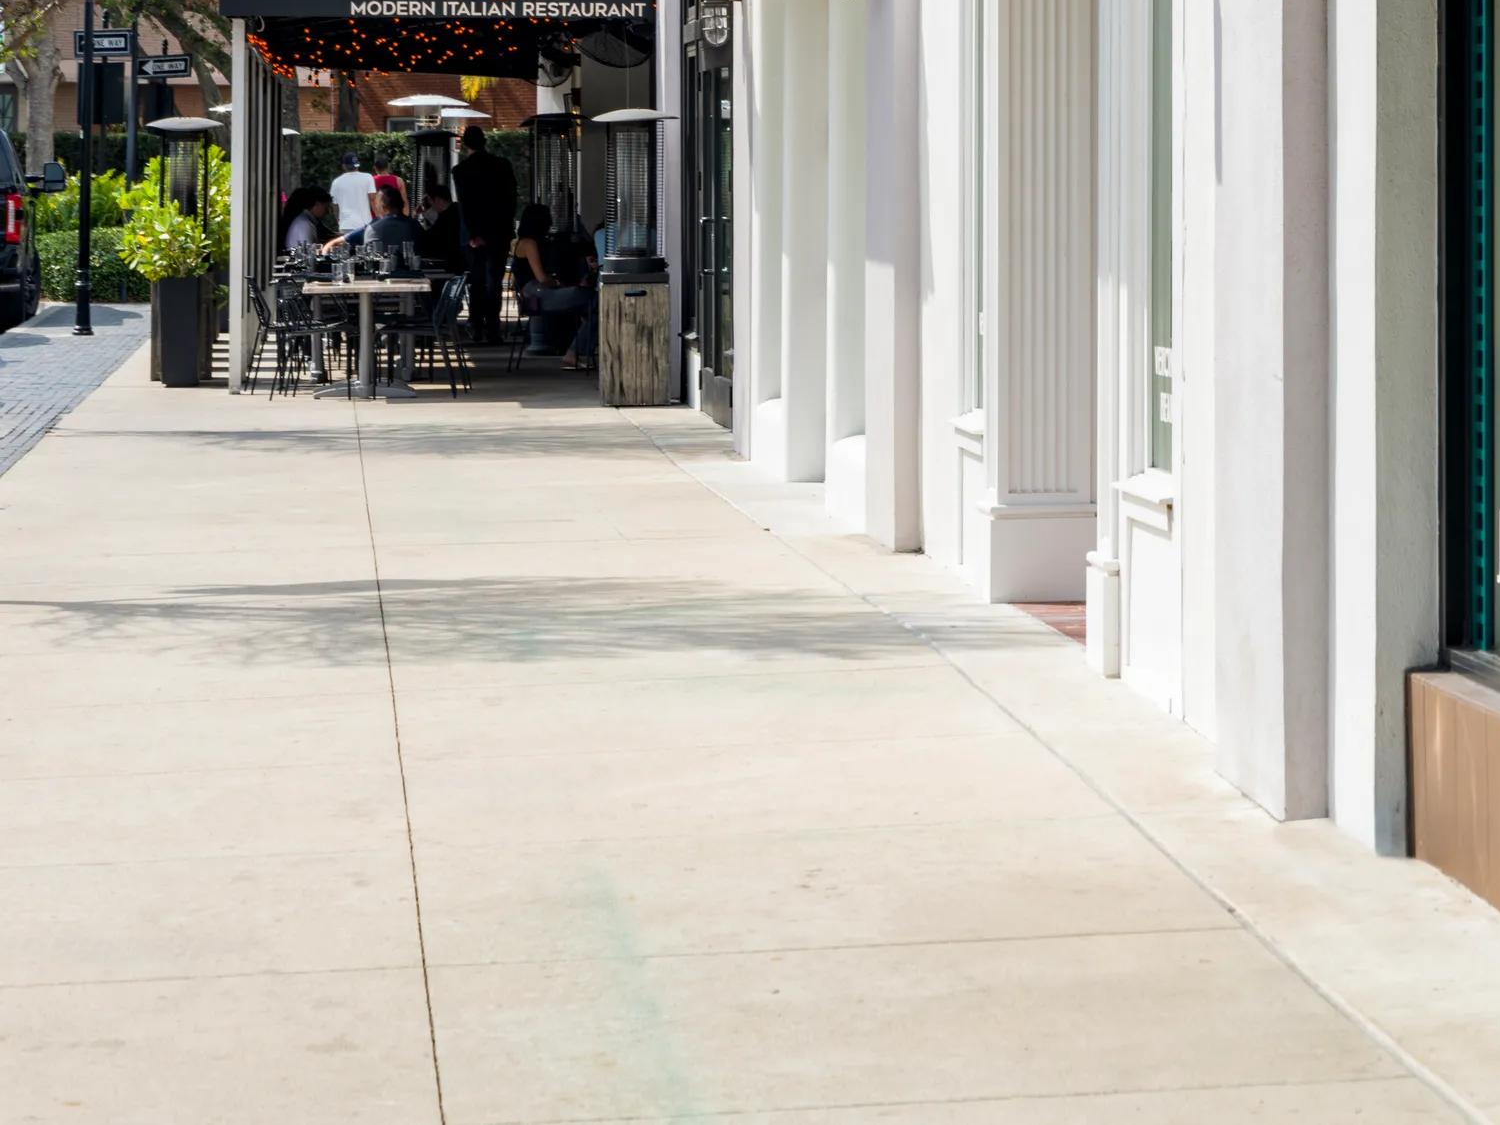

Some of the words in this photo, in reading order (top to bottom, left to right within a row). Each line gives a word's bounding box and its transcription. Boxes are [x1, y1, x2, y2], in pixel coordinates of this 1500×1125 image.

[350, 1, 436, 16] MODERN
[443, 1, 516, 17] ITALIAN
[523, 2, 647, 18] RESTAURANT
[109, 38, 123, 46] WAY
[153, 62, 165, 70] ONE
[168, 61, 184, 69] WAY
